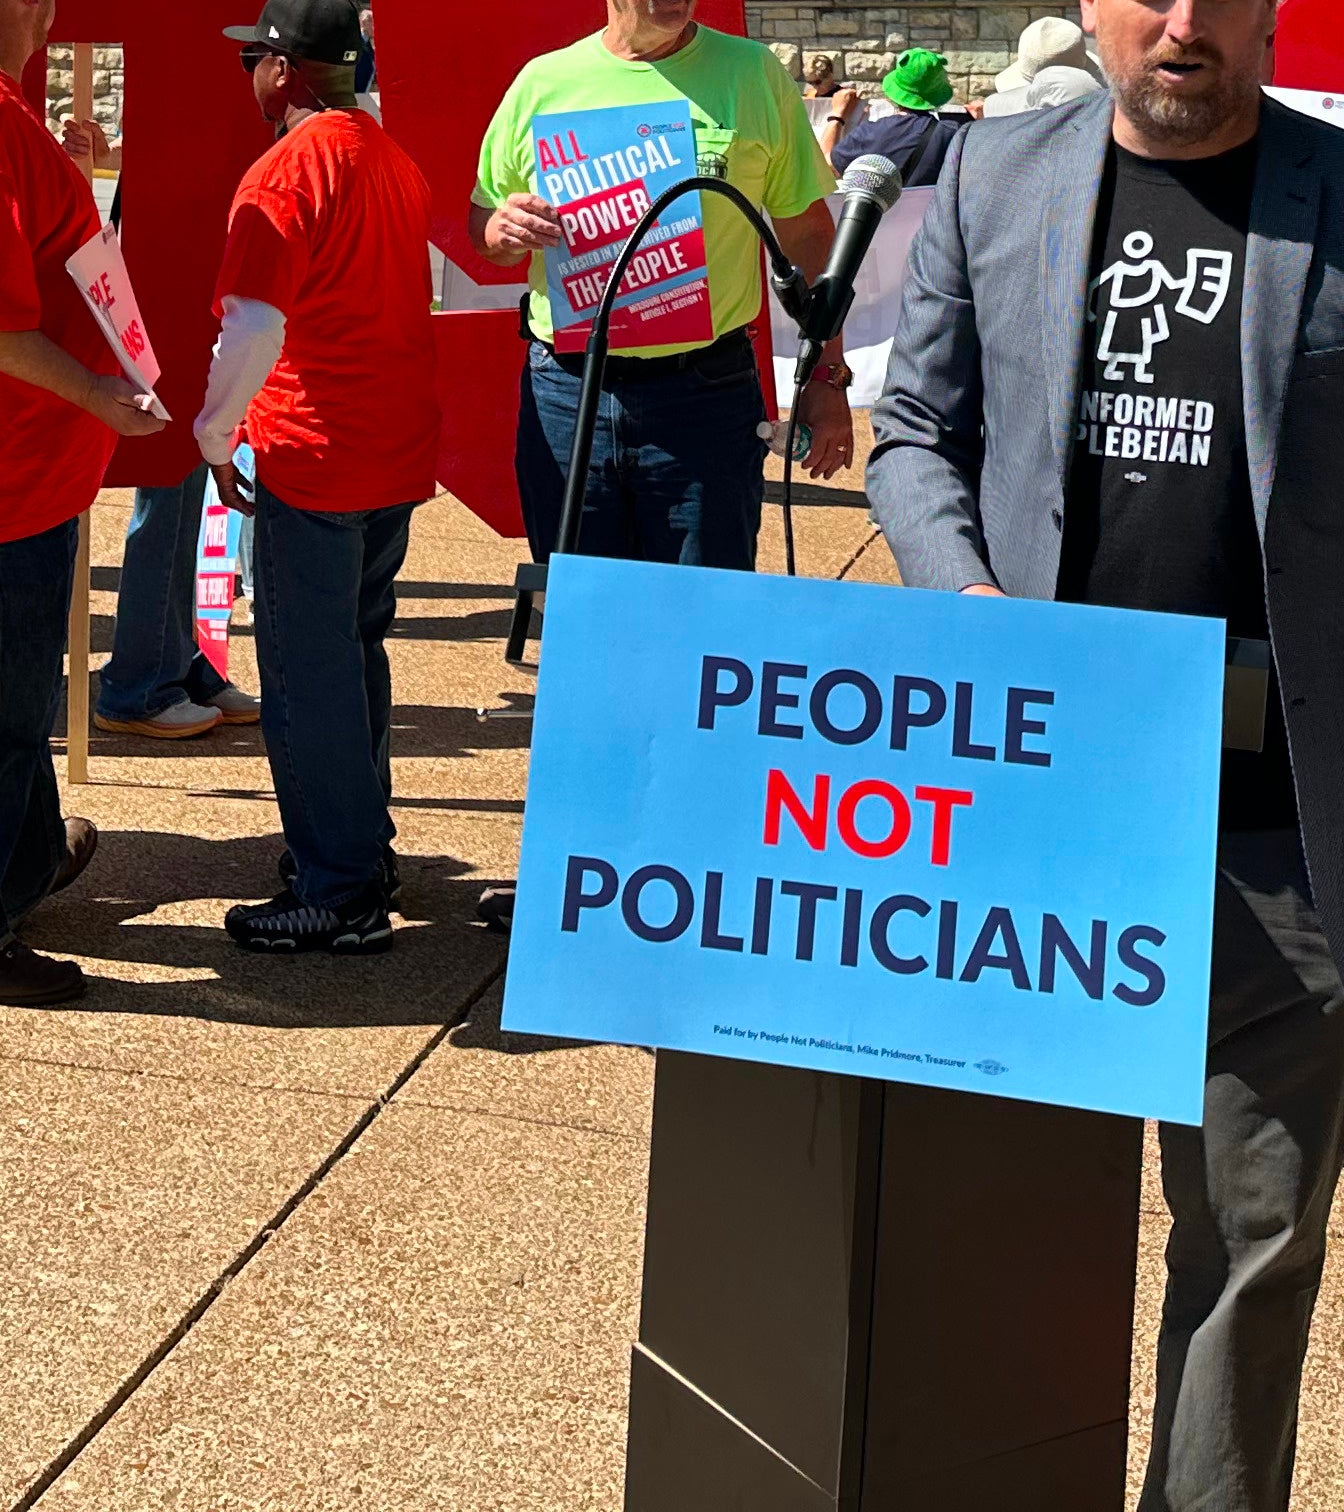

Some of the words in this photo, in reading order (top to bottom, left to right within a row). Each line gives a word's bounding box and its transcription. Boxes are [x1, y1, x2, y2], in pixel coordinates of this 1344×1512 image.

[537, 129, 589, 172] ALL
[544, 135, 681, 207] POLITICAL
[560, 187, 652, 248] POWER
[671, 216, 699, 236] FROM
[567, 271, 607, 308] THE
[1080, 390, 1215, 433] NFORMED
[696, 655, 1056, 768] PEOPLE
[763, 769, 973, 868] NOT
[560, 854, 1167, 1009] POLITICIANS
[713, 1024, 733, 1036] Paid
[733, 1027, 747, 1037] for
[747, 1029, 759, 1041] by
[759, 1030, 789, 1044] People
[790, 1035, 807, 1047] Not
[856, 1044, 879, 1057] Mike
[924, 1053, 967, 1069] Treasurer
